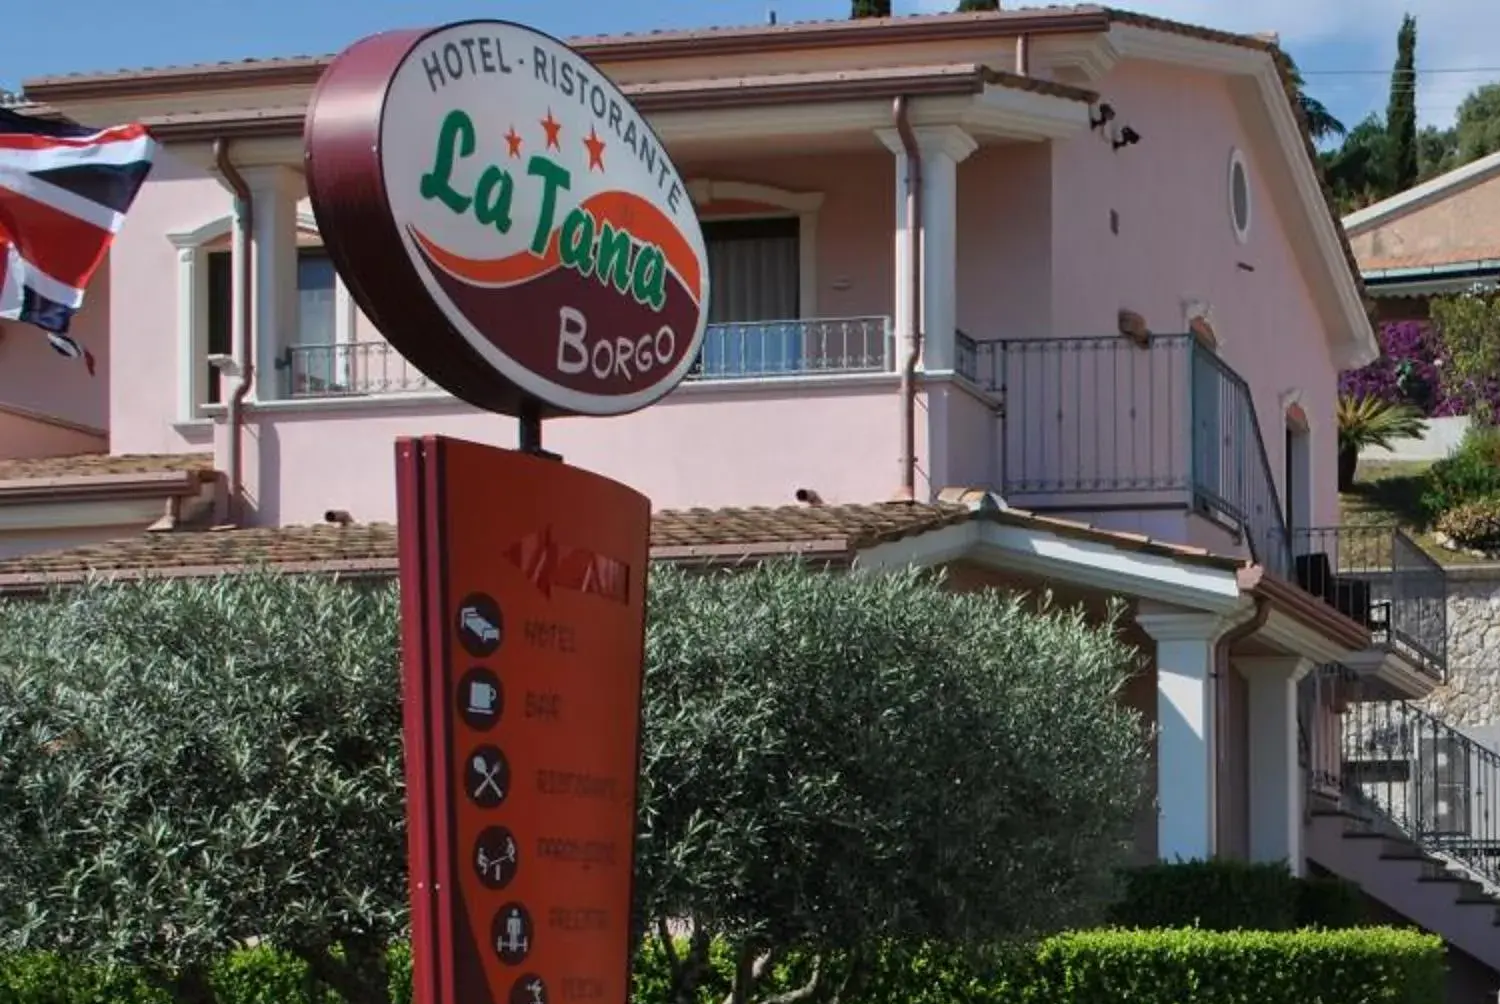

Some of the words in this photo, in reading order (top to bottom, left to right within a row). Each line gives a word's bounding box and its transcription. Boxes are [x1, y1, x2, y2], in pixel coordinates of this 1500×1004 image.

[419, 109, 514, 235] La
[527, 155, 668, 312] Tana
[422, 36, 512, 92] HOTEL
[532, 46, 685, 216] RISTORANTE
[556, 305, 676, 381] BORGO
